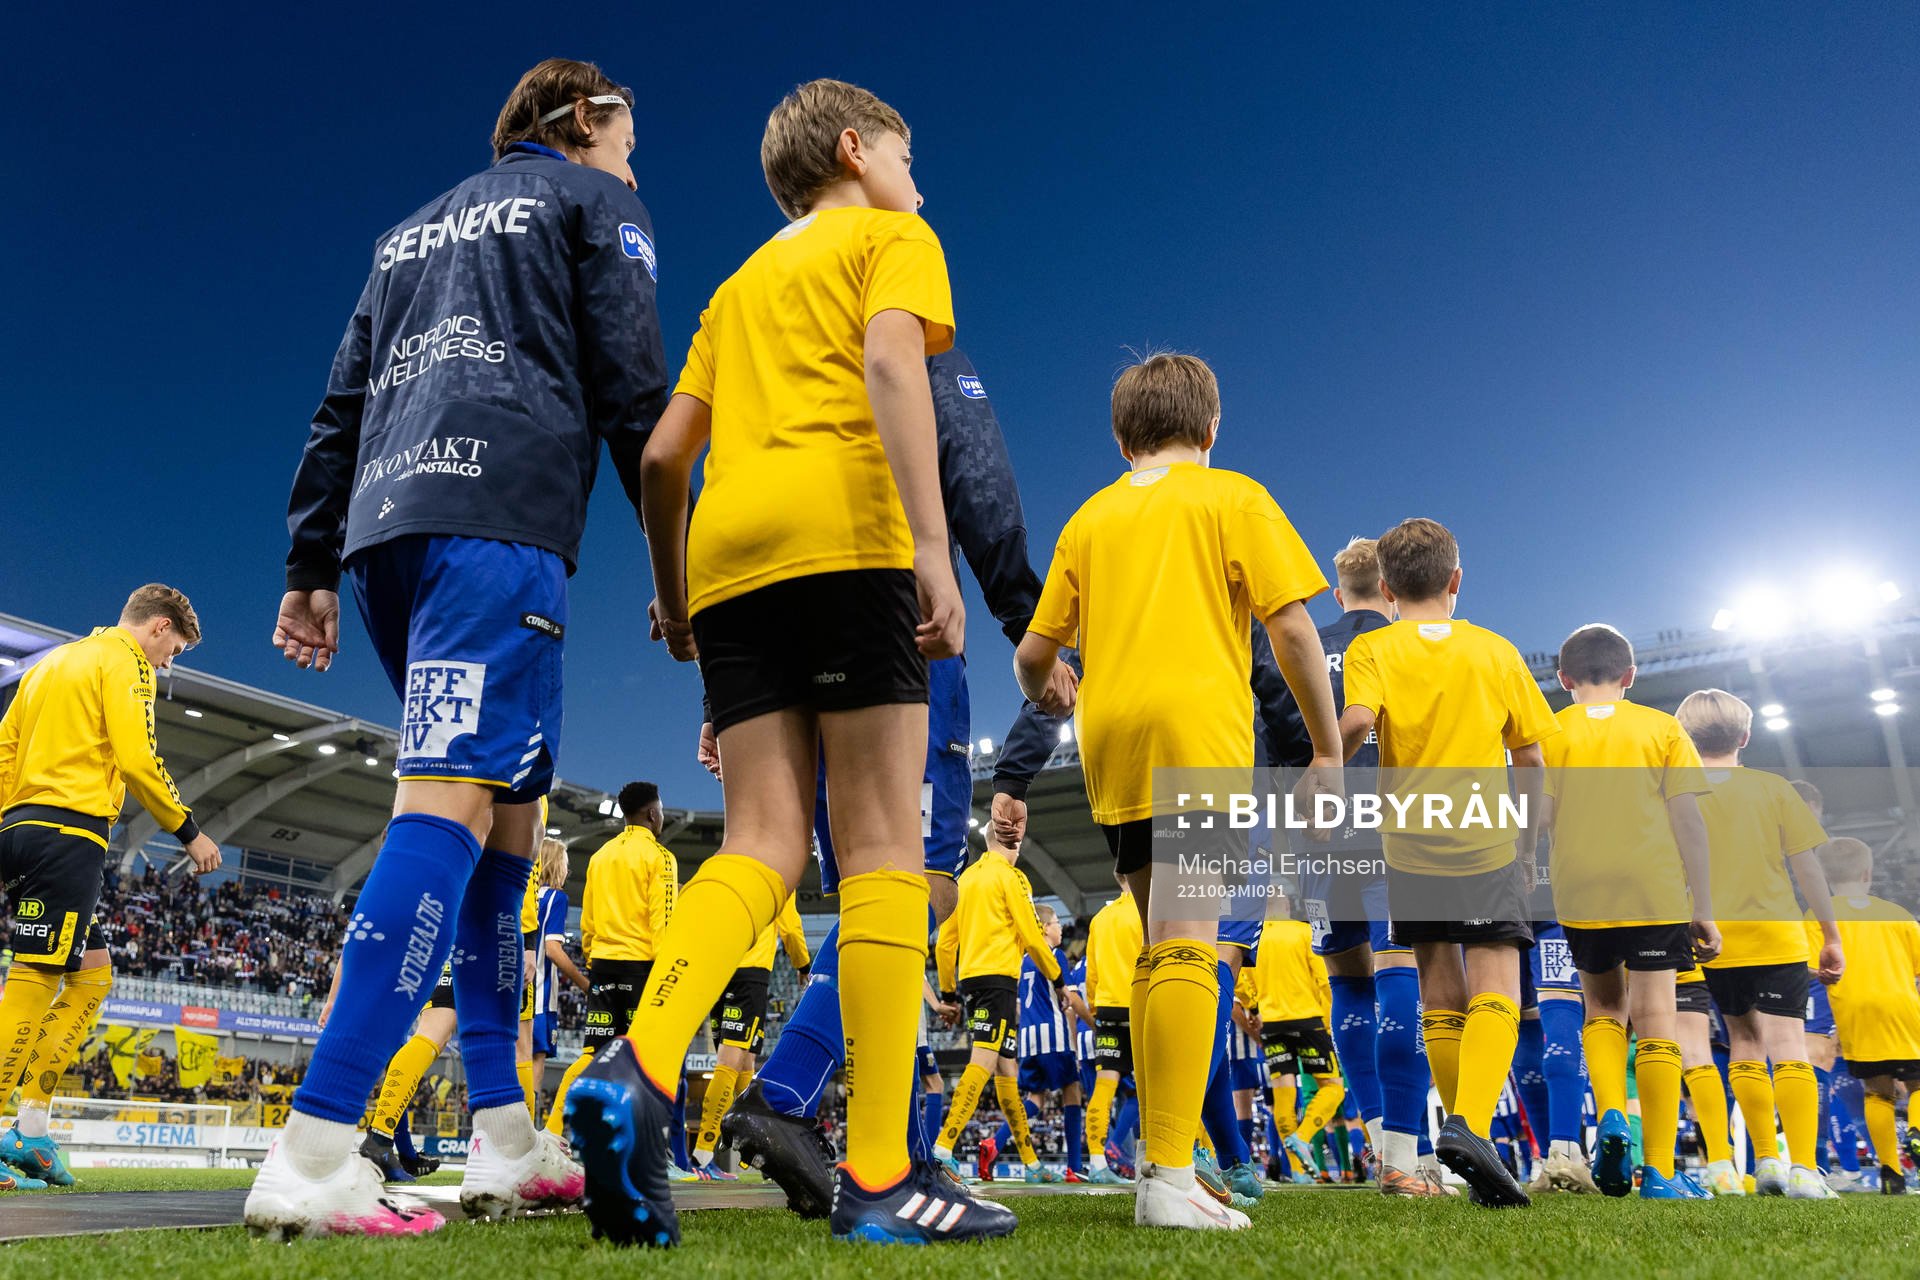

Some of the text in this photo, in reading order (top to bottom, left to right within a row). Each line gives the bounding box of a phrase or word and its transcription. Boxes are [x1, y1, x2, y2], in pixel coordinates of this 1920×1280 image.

[389, 315, 481, 363] NORDIC
[369, 337, 506, 397] WELLNESS
[415, 461, 482, 477] INSTALCO
[410, 667, 467, 695] EFF
[407, 695, 472, 723] EKT
[270, 828, 300, 841] B3
[17, 901, 40, 917] AB
[650, 958, 689, 1007] umbro
[723, 1008, 739, 1018] AB
[50, 997, 100, 1065] VINNERGI
[0, 1020, 31, 1103] INNERGI
[136, 1125, 196, 1147] STENA
